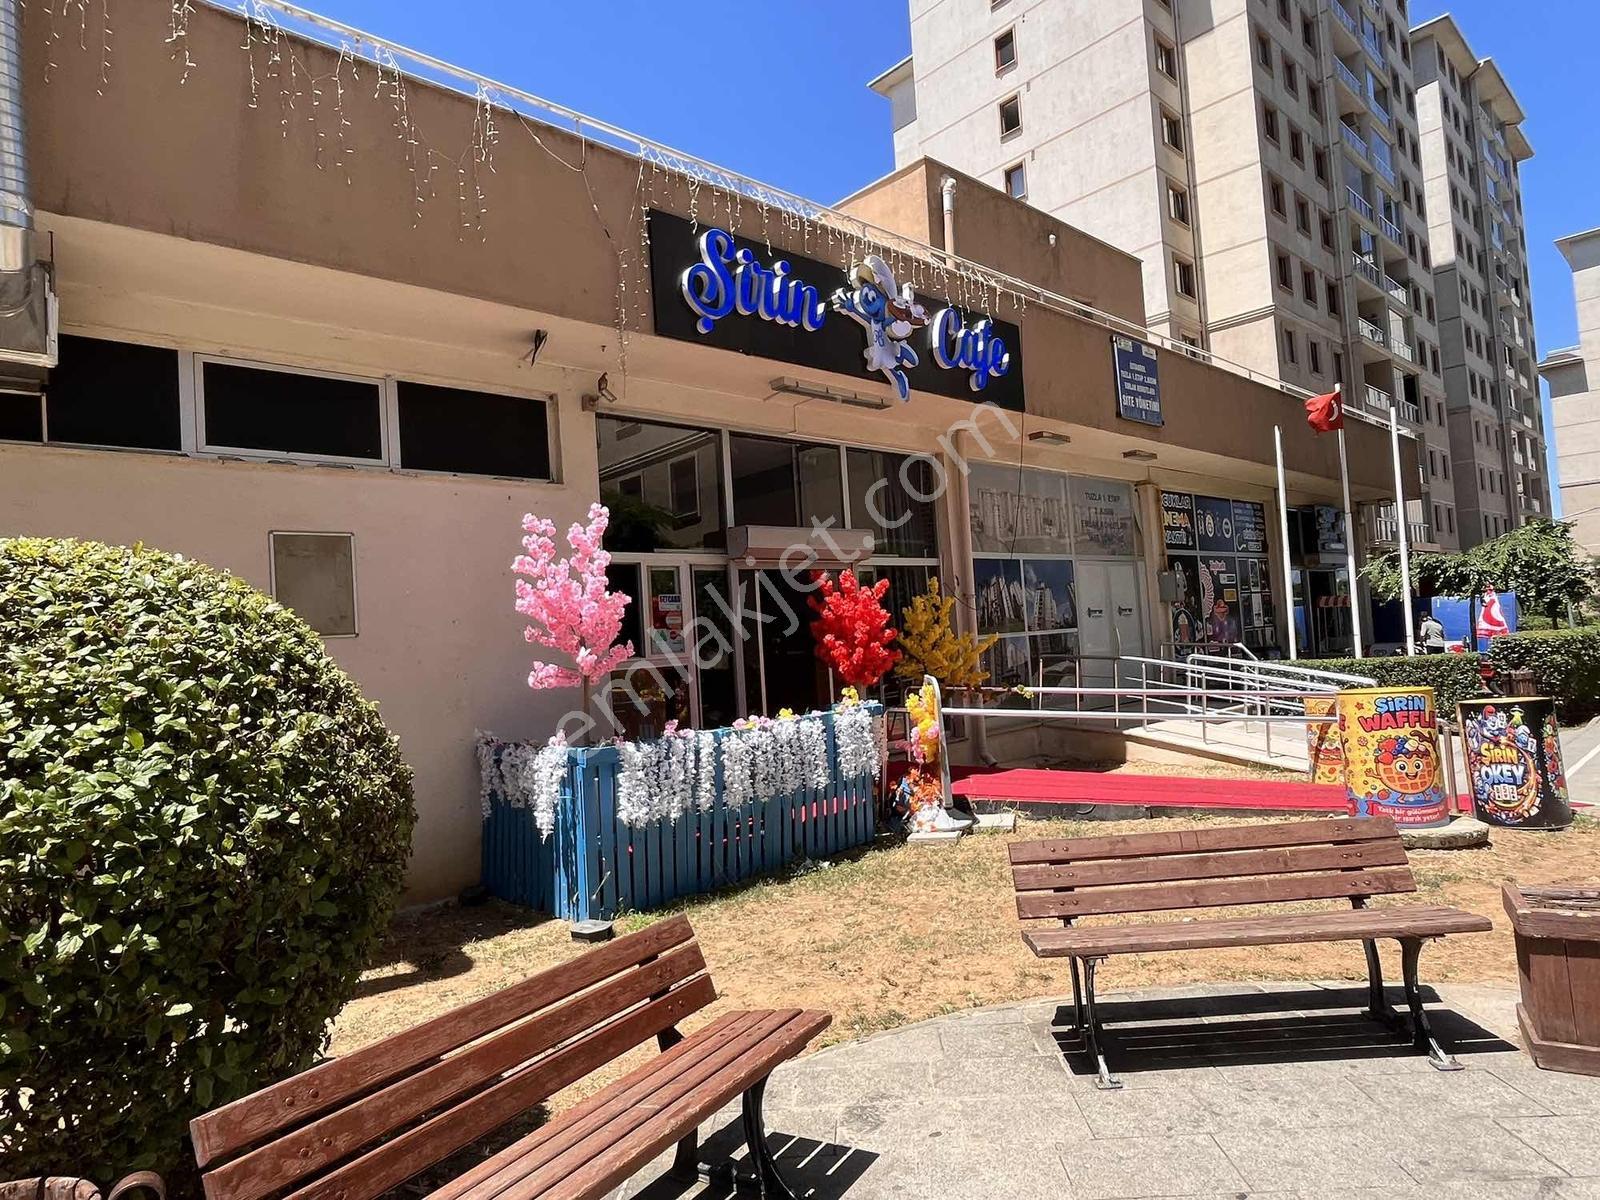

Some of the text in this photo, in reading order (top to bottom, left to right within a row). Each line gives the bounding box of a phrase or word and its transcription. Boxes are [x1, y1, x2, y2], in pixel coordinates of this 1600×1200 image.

[683, 228, 1010, 391] Şirin Cafe
[1480, 763, 1525, 786] OKEY
